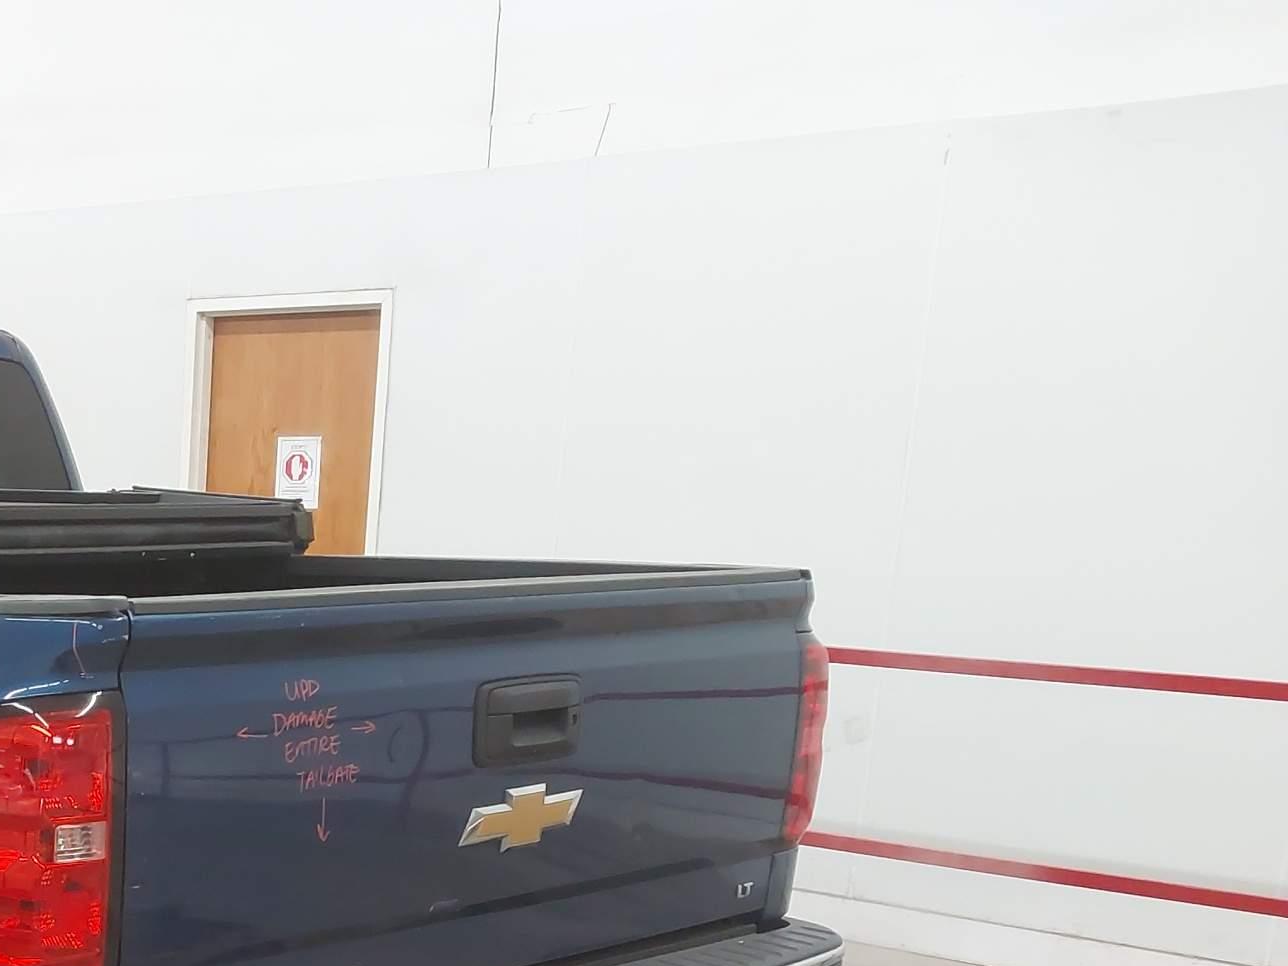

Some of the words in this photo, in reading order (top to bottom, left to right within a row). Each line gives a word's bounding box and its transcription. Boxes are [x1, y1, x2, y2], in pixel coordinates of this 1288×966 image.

[284, 679, 320, 701] UPD
[272, 706, 338, 737] DAMAGE
[296, 763, 361, 792] TAILGATE
[737, 881, 754, 898] LT
